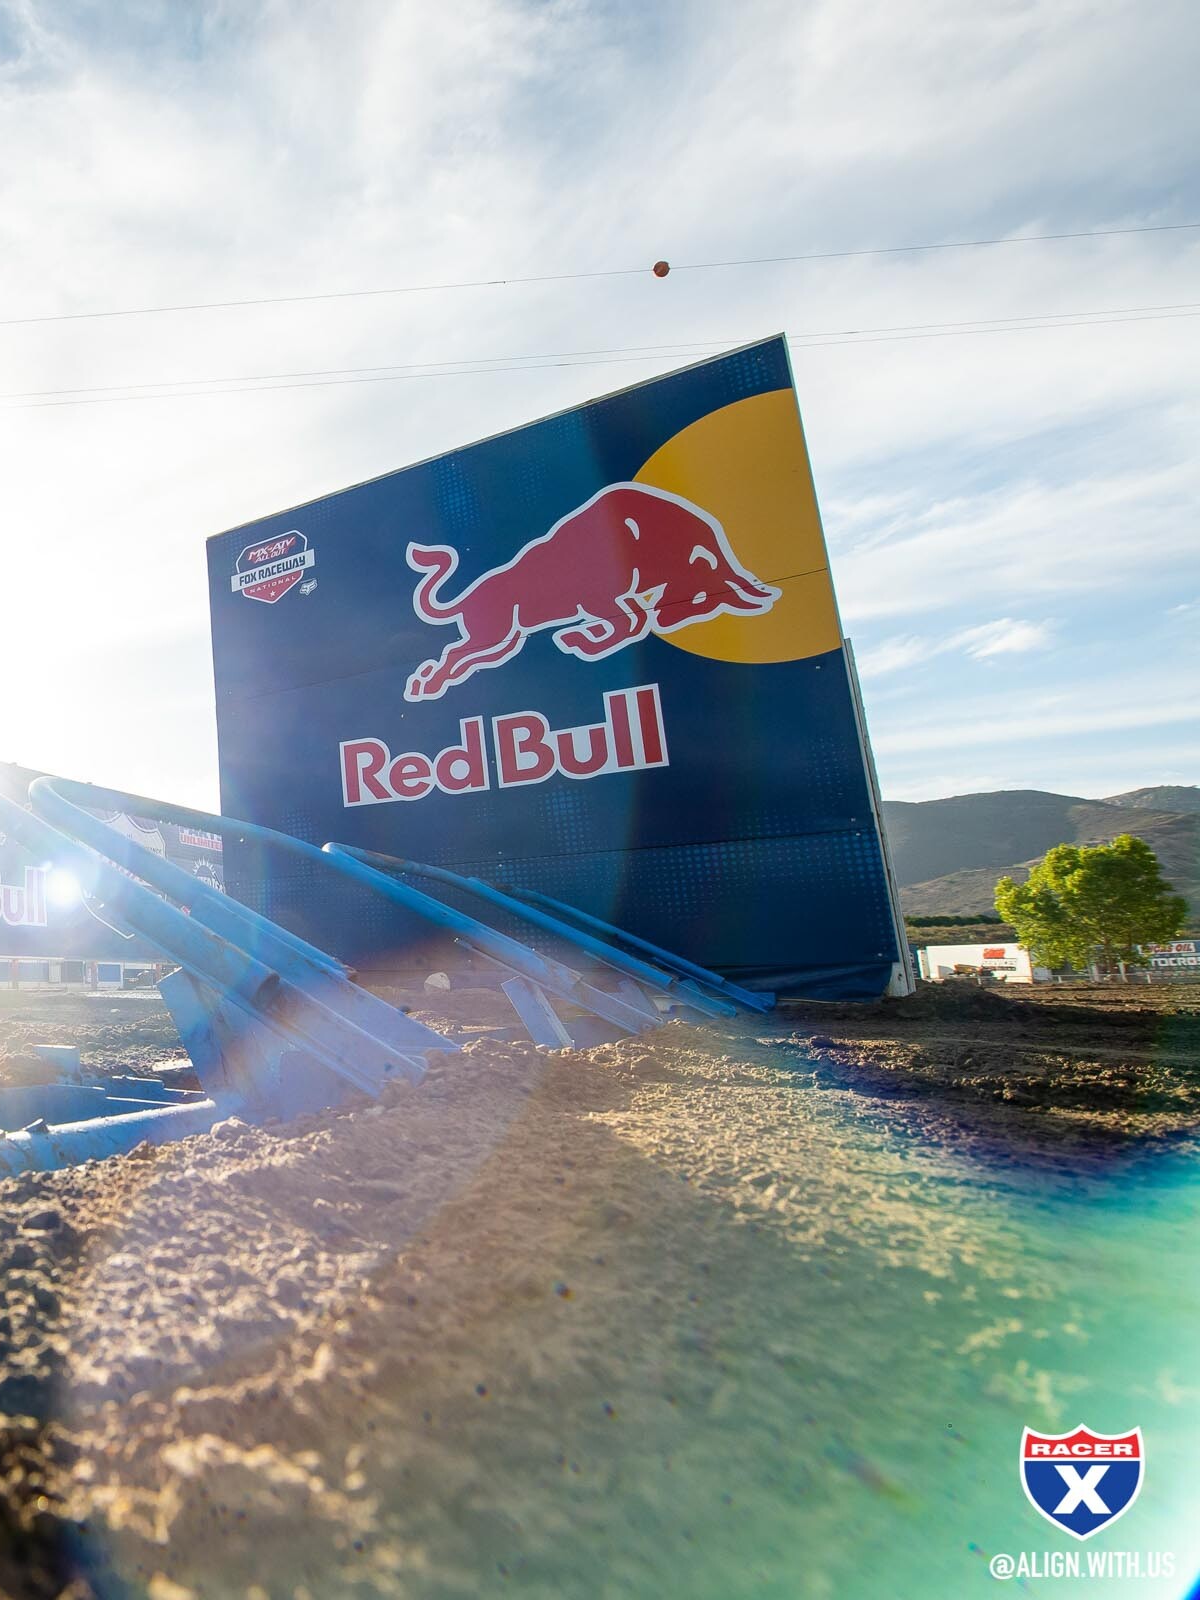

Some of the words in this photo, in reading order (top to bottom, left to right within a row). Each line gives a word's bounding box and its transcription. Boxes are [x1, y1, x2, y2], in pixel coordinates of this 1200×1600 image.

[254, 552, 270, 563] ALL
[271, 548, 287, 560] OUT
[239, 571, 257, 587] FOX
[258, 555, 306, 580] RACEWAY
[249, 575, 296, 593] NATIONAL
[341, 717, 489, 806] Red
[493, 685, 667, 786] Bull
